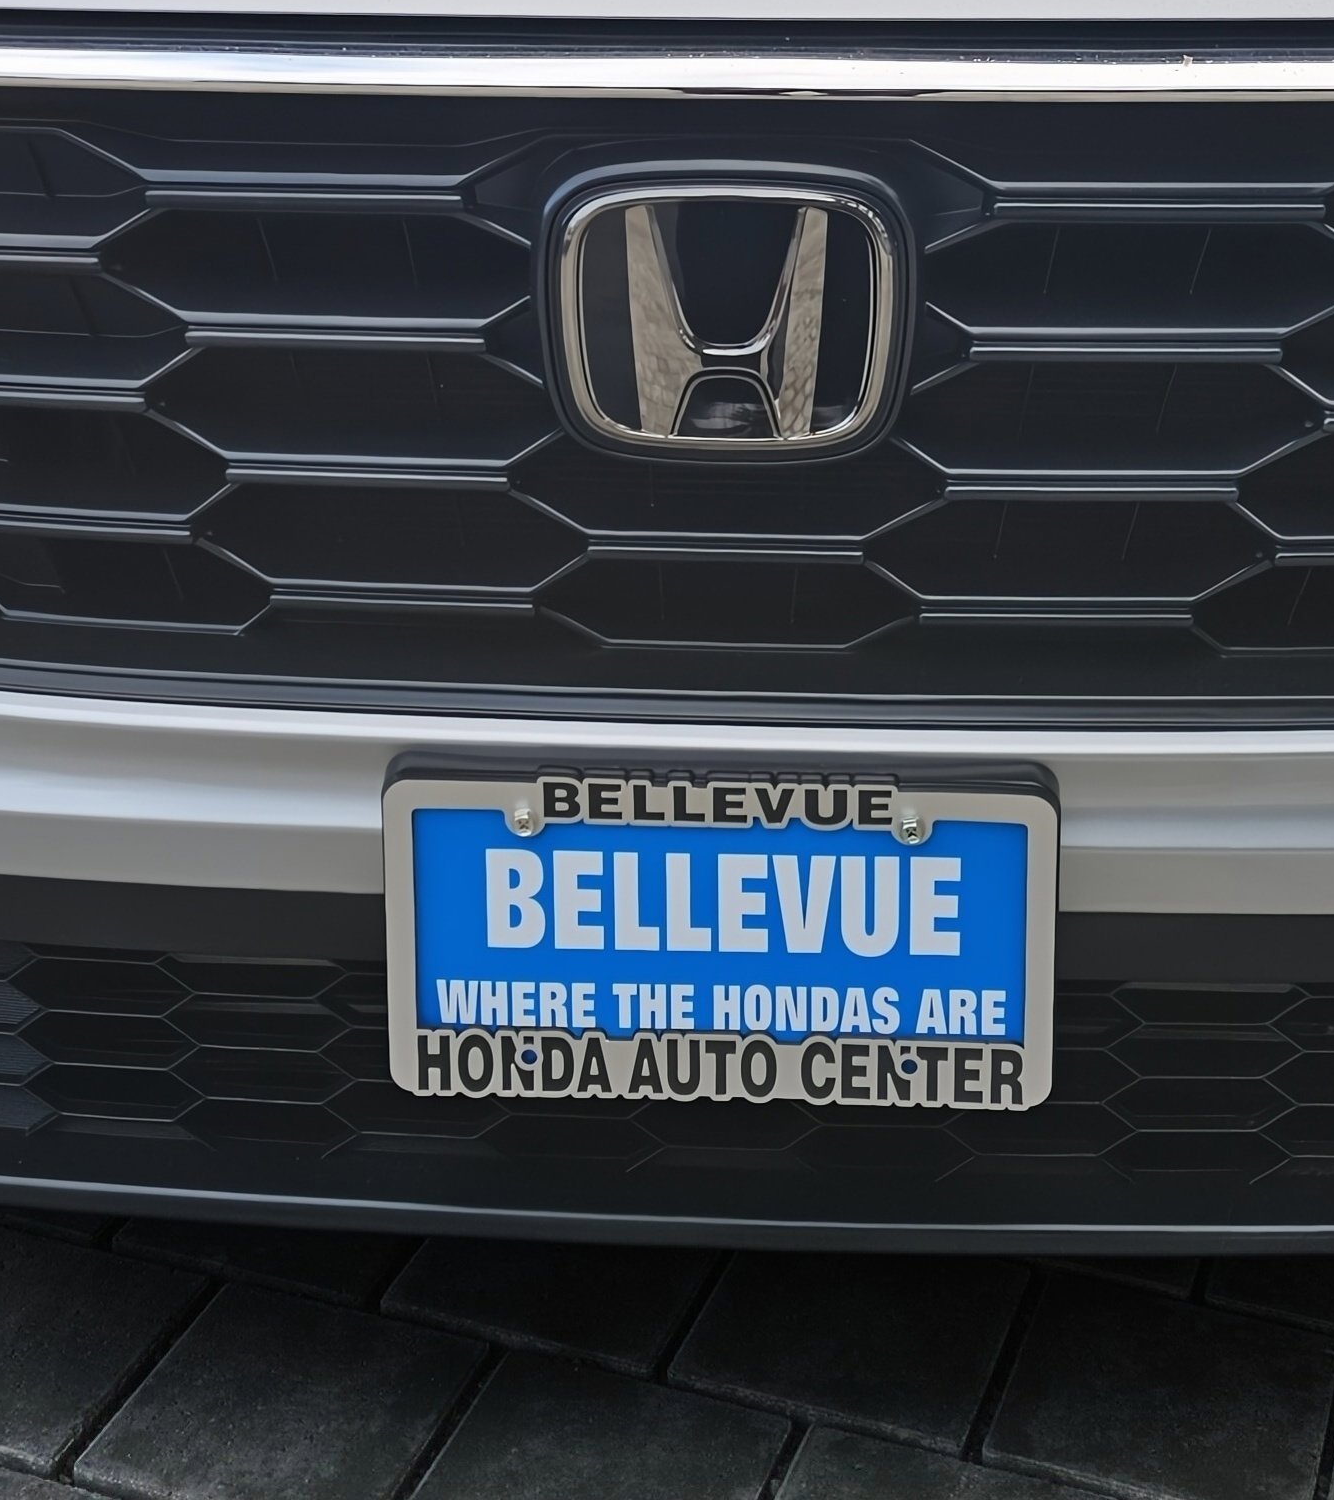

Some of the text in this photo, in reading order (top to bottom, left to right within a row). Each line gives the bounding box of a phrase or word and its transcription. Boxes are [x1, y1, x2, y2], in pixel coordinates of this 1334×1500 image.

[542, 781, 893, 826] BELLEVUE
[485, 848, 961, 956] BELLEVUE
[437, 980, 1006, 1035] WHERE THE HONDAS ARE
[416, 1034, 1024, 1105] HONDA AUTO CENTER
